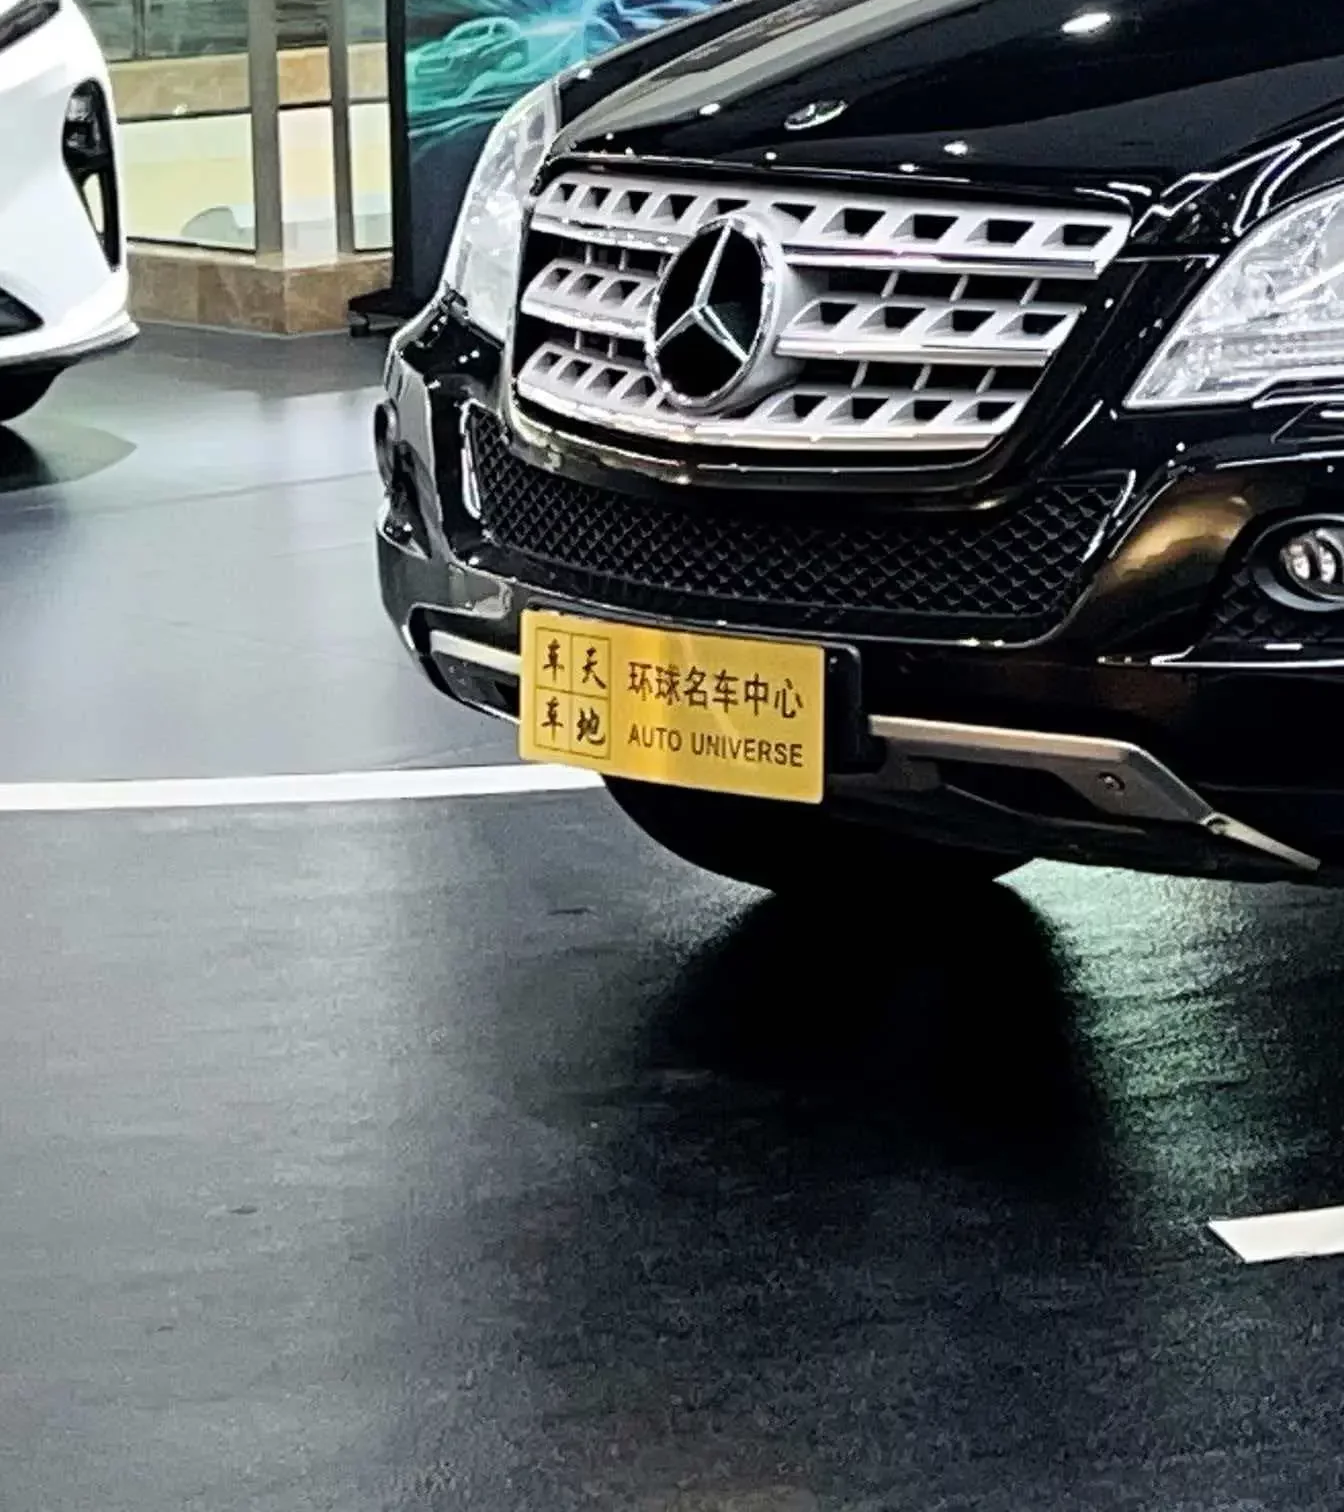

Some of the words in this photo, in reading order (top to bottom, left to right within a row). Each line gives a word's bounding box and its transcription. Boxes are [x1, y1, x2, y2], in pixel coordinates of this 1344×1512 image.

[627, 661, 804, 719] 环球名车中心
[627, 723, 683, 752] AUTO
[690, 732, 804, 768] UNIVERSE
